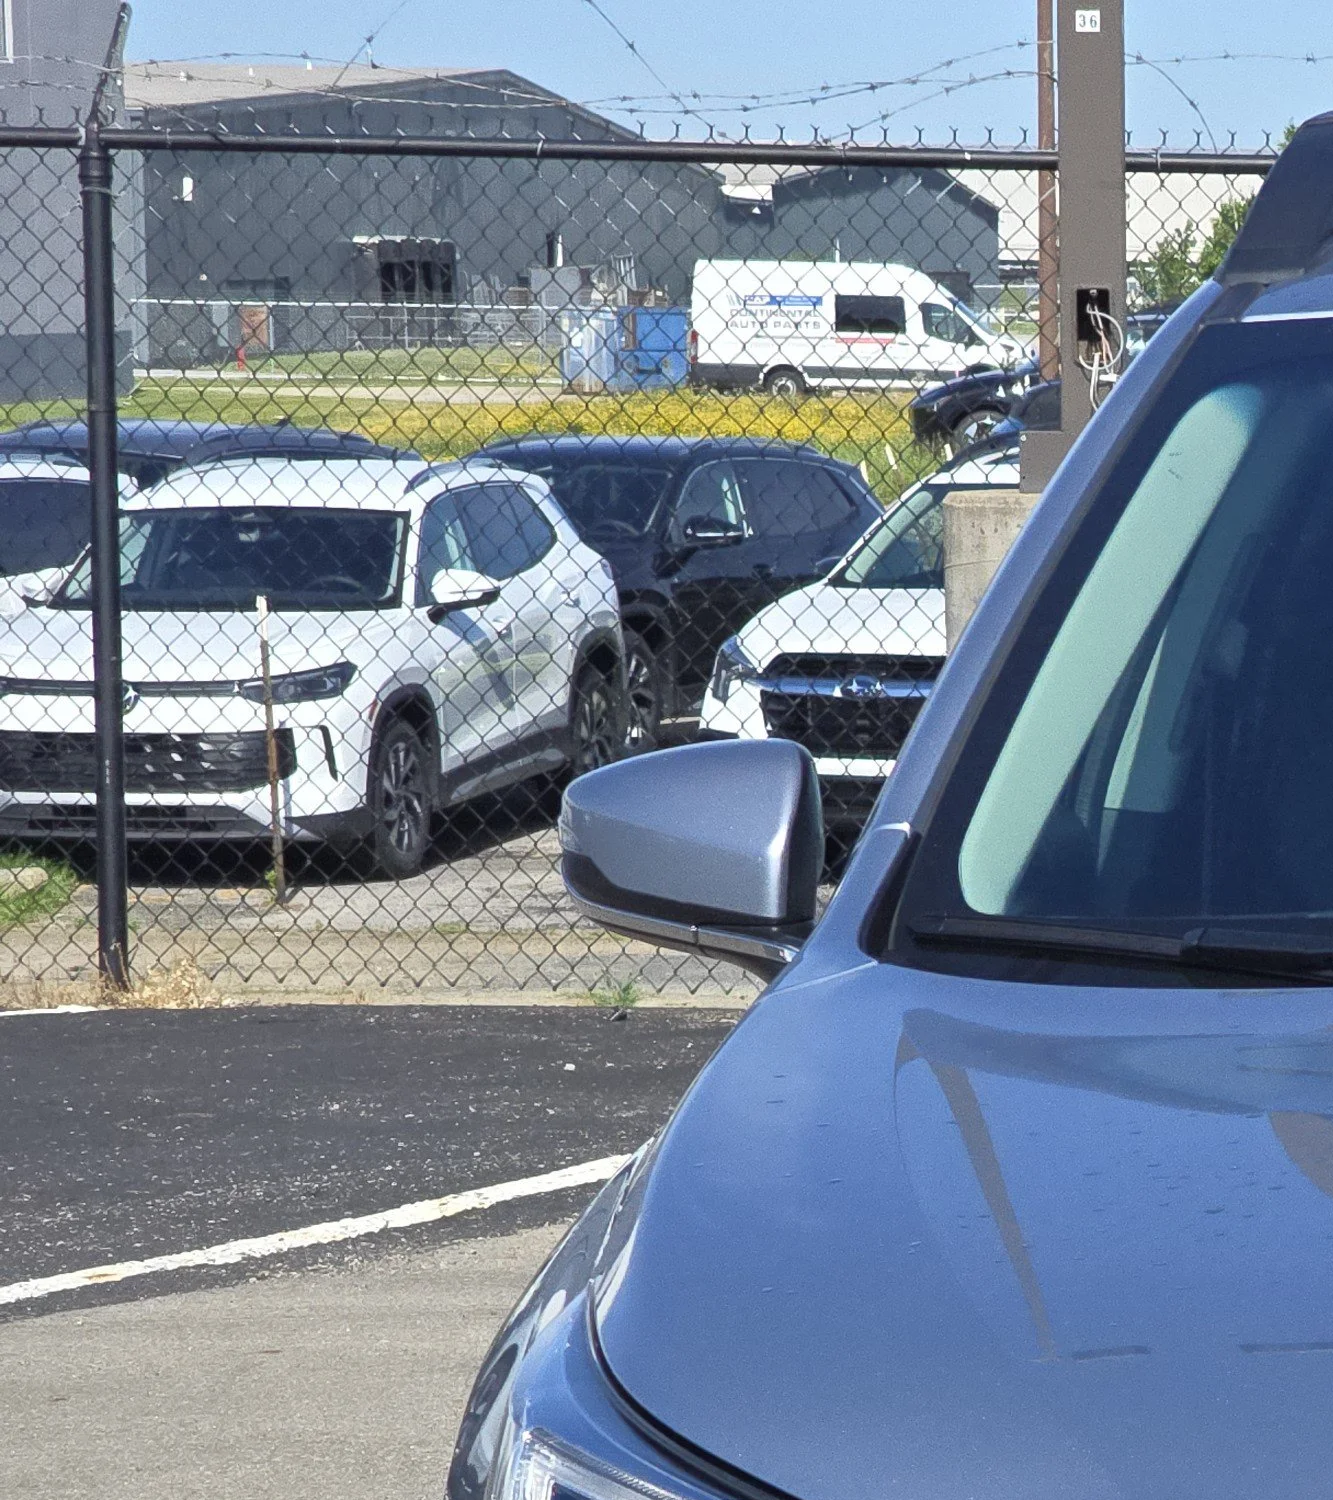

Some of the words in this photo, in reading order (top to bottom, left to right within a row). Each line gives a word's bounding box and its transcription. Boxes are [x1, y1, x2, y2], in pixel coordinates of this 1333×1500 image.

[1078, 14, 1098, 29] 36
[729, 308, 820, 318] CONTINENTAL
[729, 320, 769, 329] AUTO
